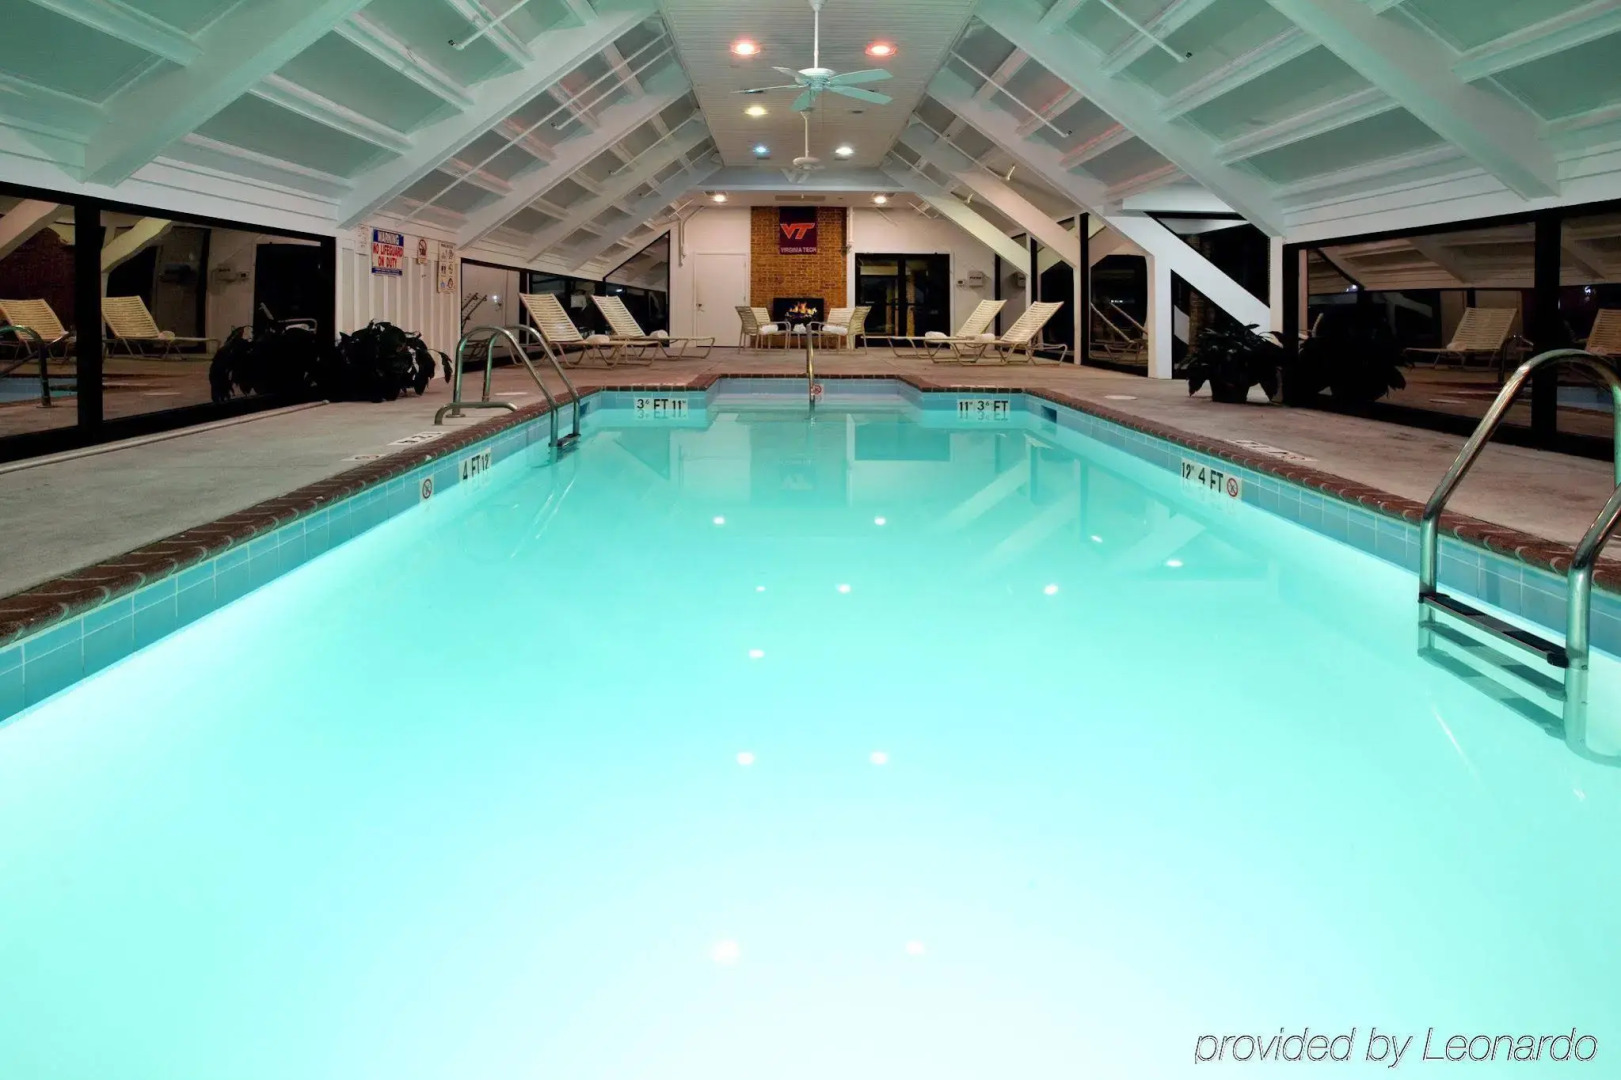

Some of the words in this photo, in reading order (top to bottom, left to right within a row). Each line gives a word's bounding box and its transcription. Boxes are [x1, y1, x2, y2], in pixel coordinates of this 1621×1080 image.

[780, 223, 816, 240] VT
[373, 243, 379, 254] NO
[380, 244, 403, 258] LIFEGUARD
[378, 256, 385, 267] ON
[386, 257, 397, 269] DUTY
[653, 398, 669, 410] FT
[993, 400, 1008, 411] FT
[462, 460, 469, 480] 4
[472, 455, 481, 478] FT
[1198, 467, 1206, 485] 4
[1210, 469, 1224, 493] FT
